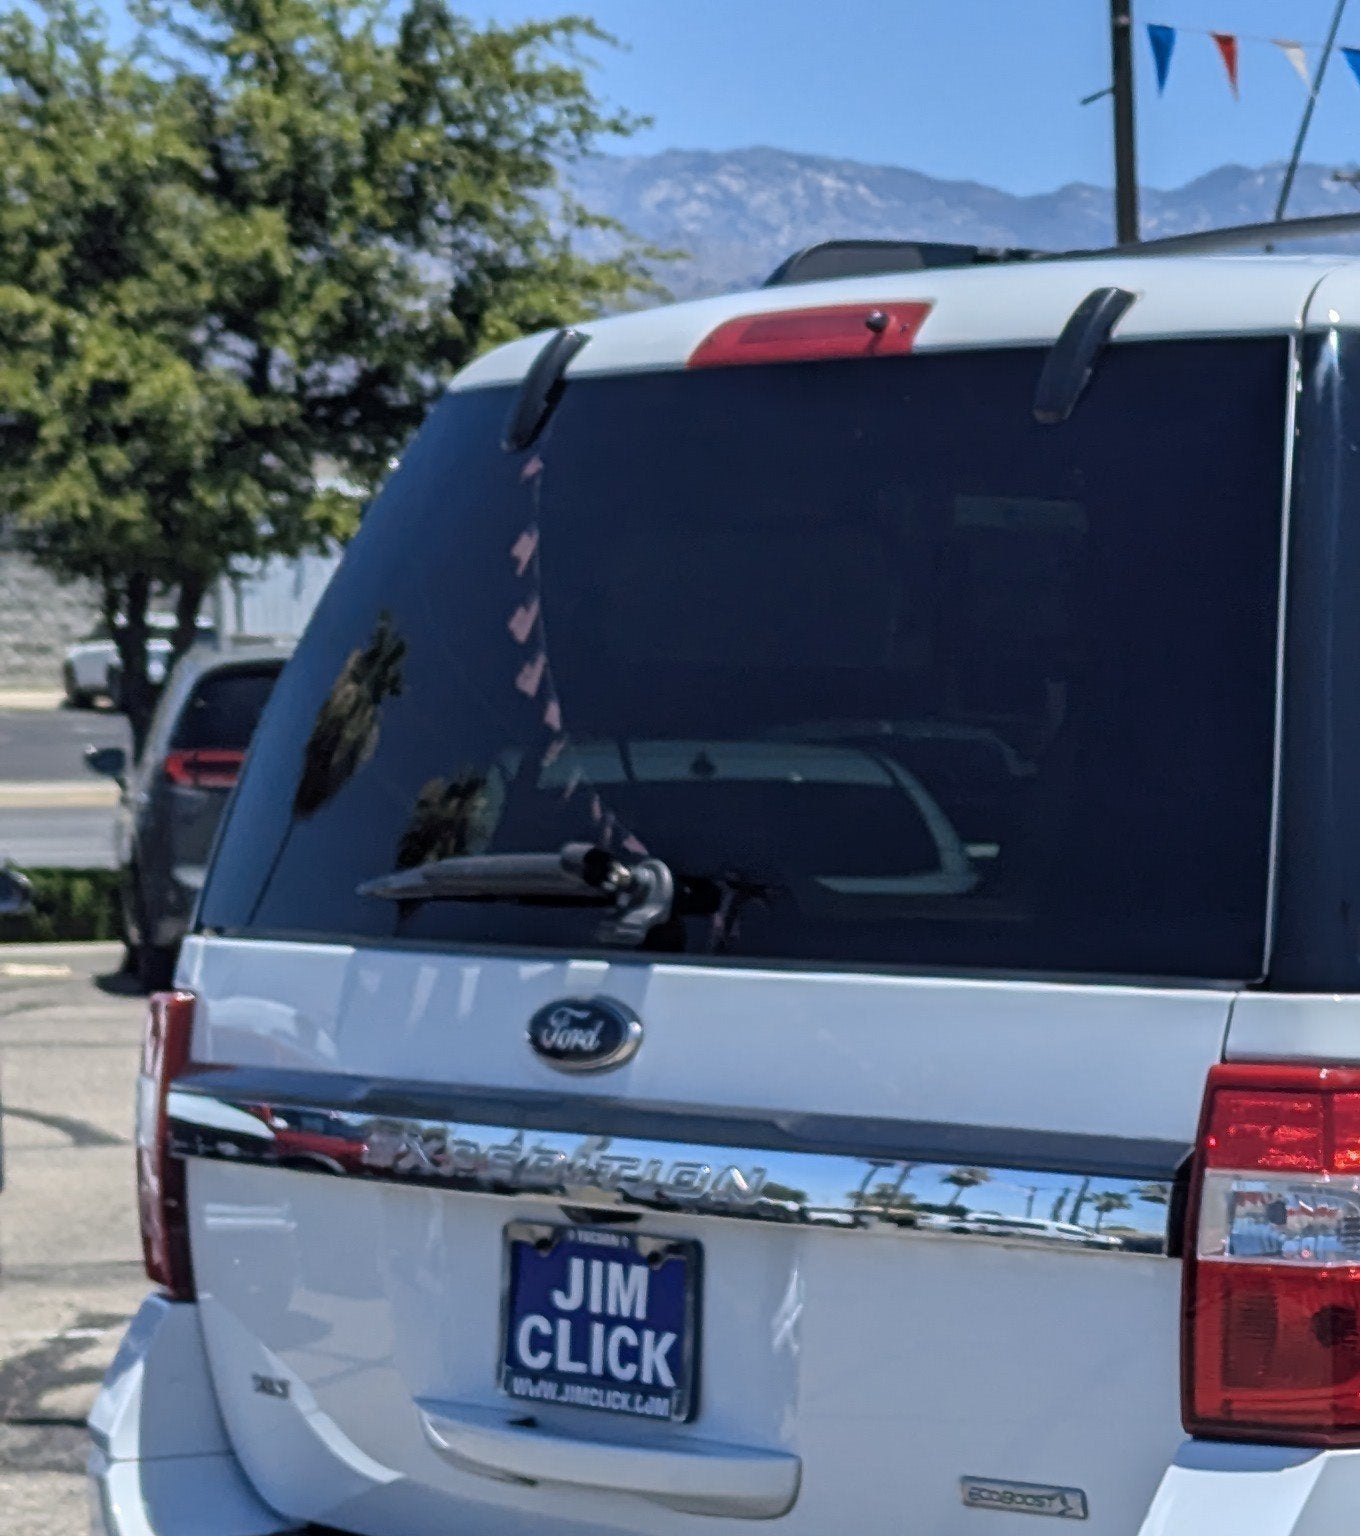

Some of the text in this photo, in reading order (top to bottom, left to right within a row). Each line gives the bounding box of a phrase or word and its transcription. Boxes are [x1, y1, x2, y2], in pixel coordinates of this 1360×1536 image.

[540, 1007, 605, 1051] Ford
[552, 1258, 649, 1320] JIM
[517, 1315, 678, 1387] CLICK
